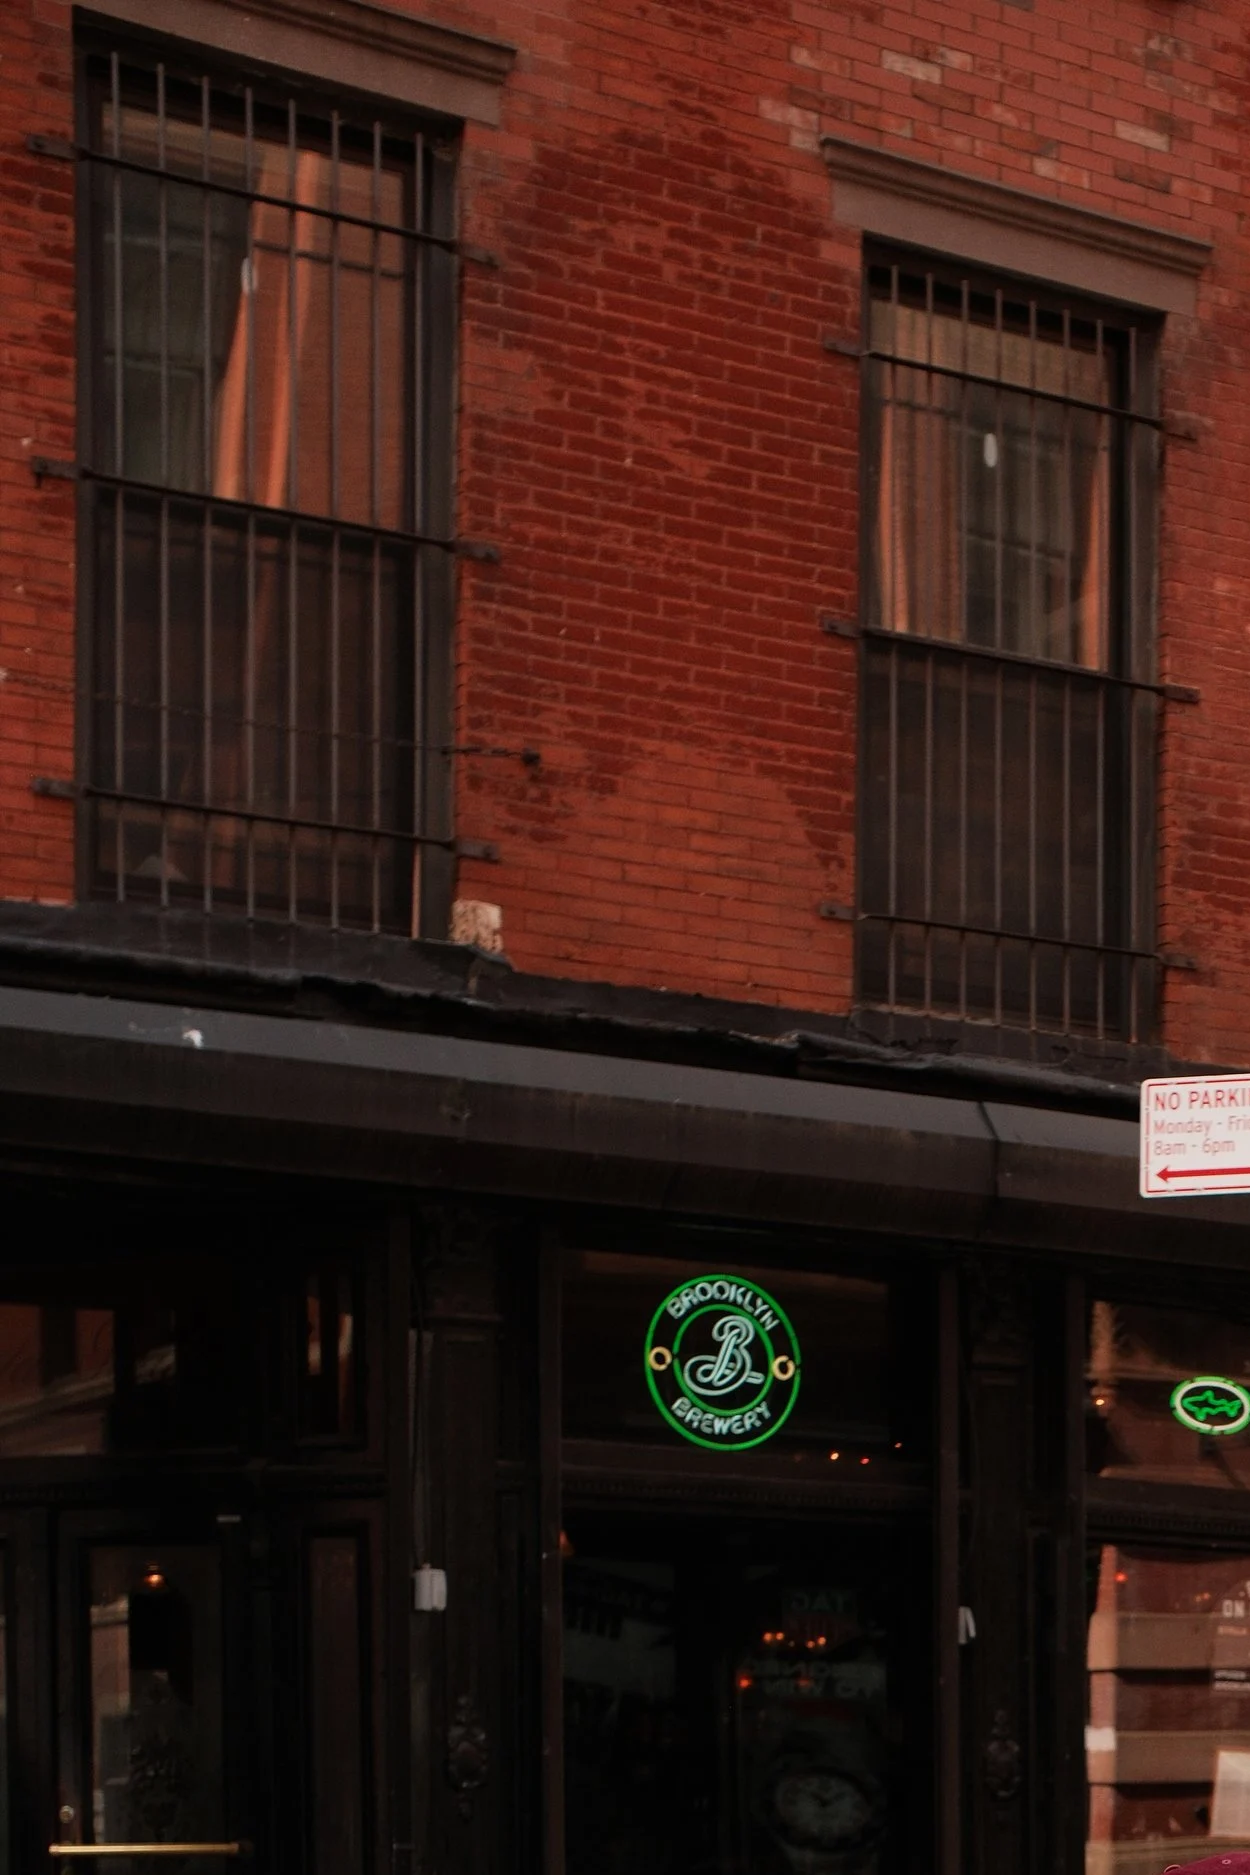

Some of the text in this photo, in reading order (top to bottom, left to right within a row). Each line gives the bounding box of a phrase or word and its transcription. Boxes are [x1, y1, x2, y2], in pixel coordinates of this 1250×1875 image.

[1154, 1091, 1180, 1111] NO
[1153, 1118, 1213, 1137] Monday
[1153, 1140, 1186, 1156] 8am
[1202, 1137, 1236, 1158] 6pm
[666, 1280, 780, 1332] BROOKLYN
[671, 1396, 772, 1436] BREWERY
[1222, 1599, 1245, 1618] ON
